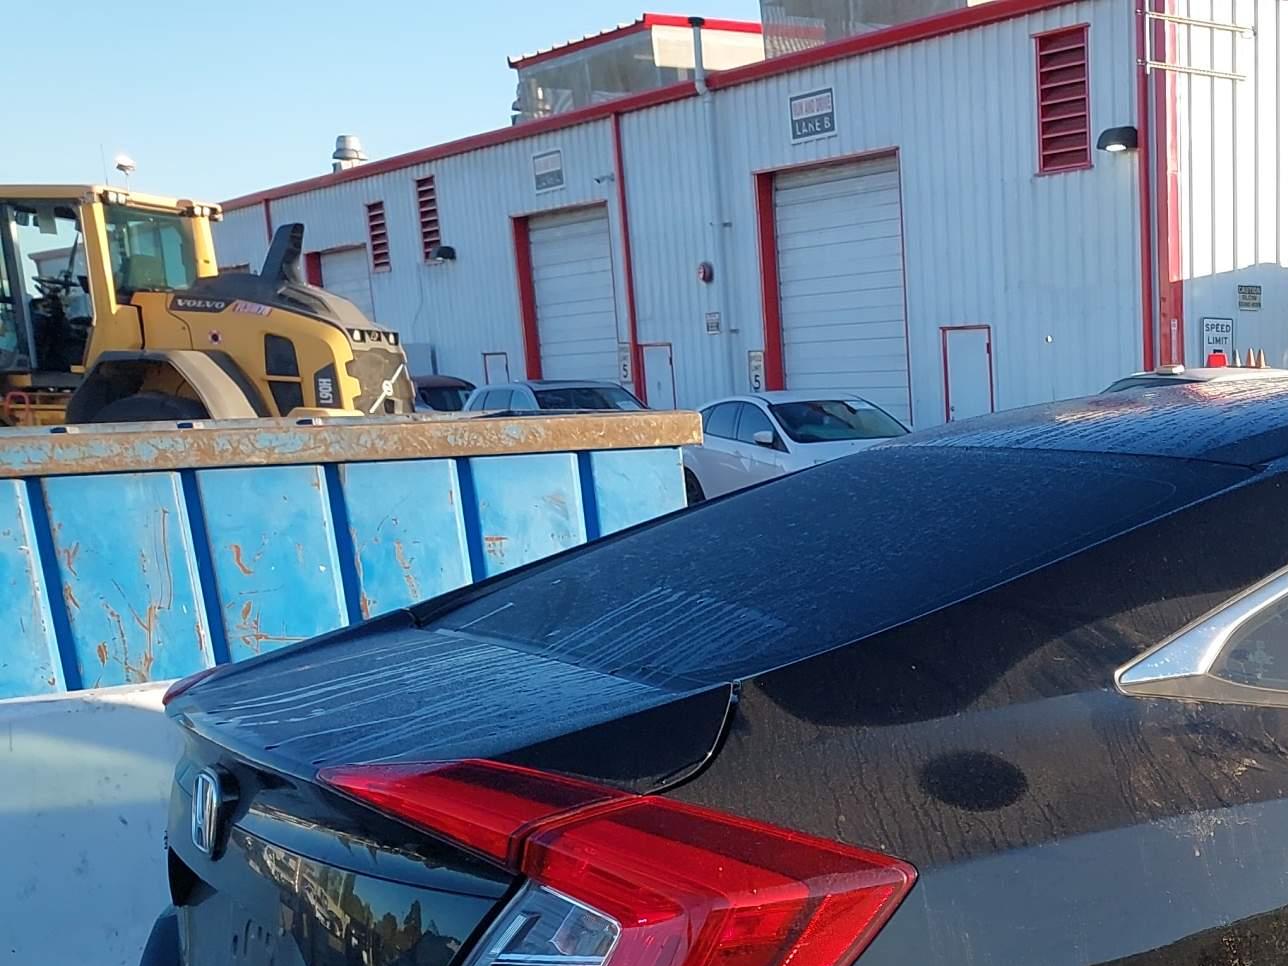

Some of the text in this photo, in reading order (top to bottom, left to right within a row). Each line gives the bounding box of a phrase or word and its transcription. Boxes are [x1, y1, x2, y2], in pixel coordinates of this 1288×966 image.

[796, 117, 831, 135] LANE B
[177, 299, 225, 310] VOLVO
[1205, 323, 1231, 333] SPEED
[1207, 336, 1229, 345] LIMIT
[622, 363, 629, 379] 5
[753, 374, 761, 391] 5
[318, 378, 333, 404] L90H
